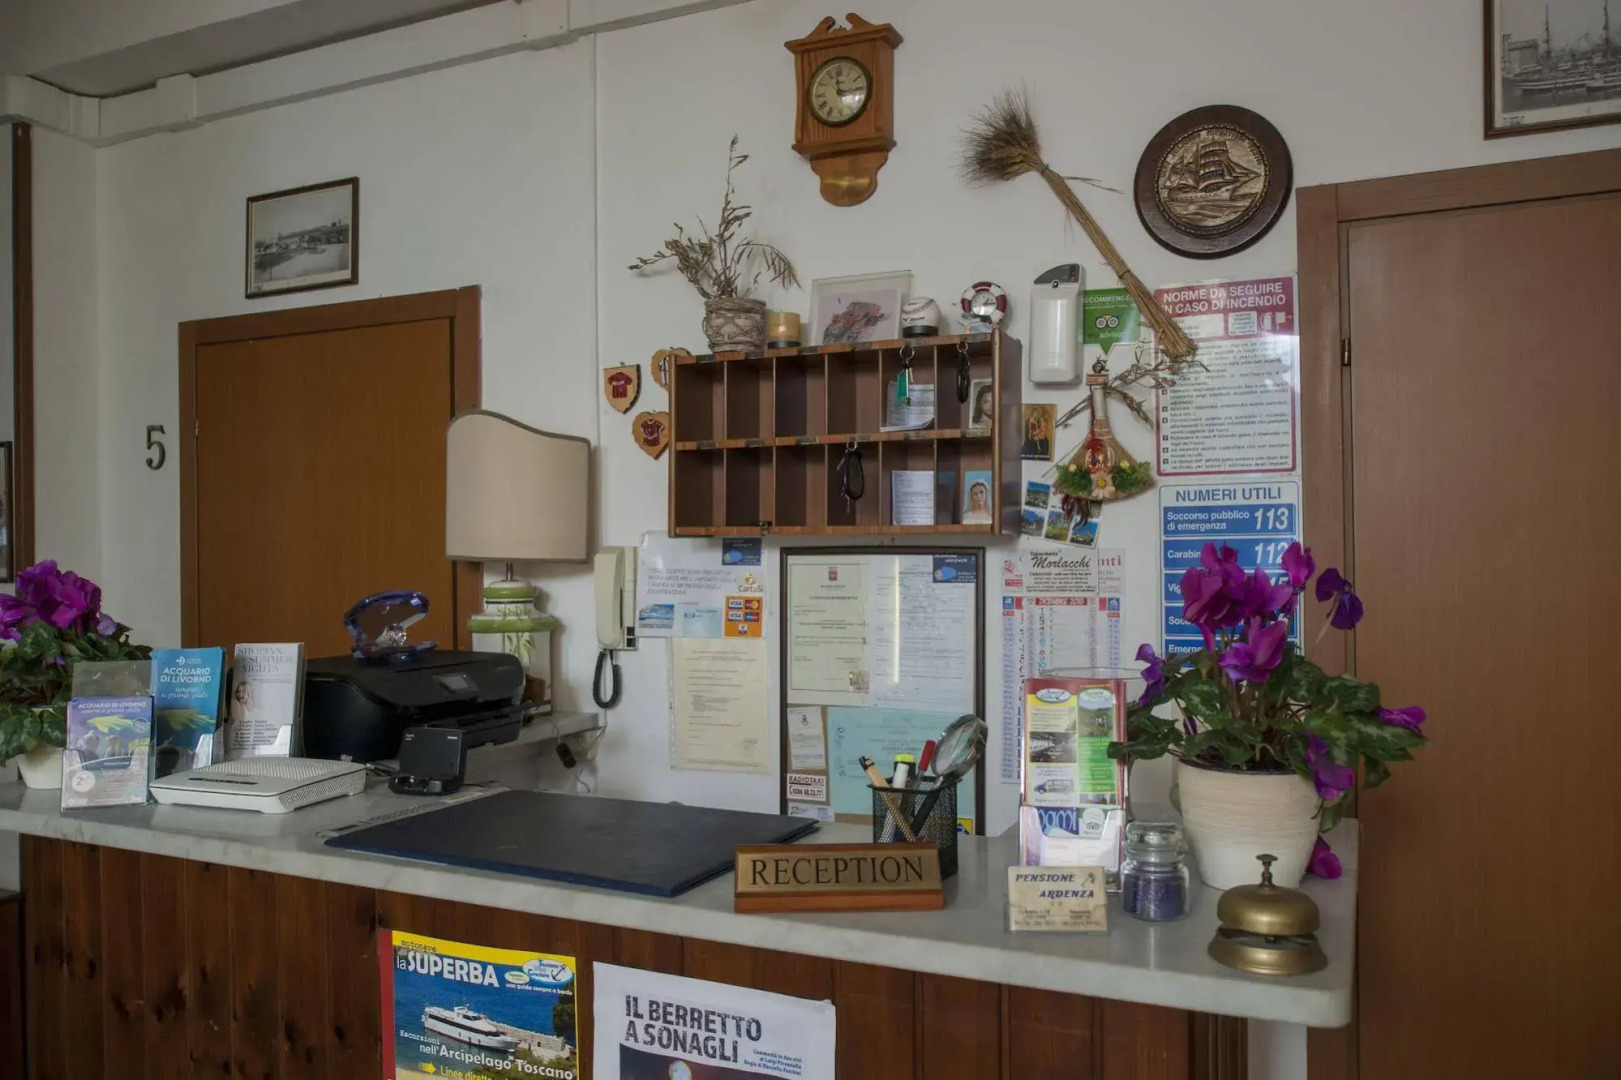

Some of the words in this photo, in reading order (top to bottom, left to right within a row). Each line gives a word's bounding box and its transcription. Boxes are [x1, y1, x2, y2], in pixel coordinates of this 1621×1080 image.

[1163, 288, 1206, 302] NORME
[1210, 288, 1226, 298] DA
[1229, 282, 1282, 297] SEGUIRE
[1175, 301, 1209, 313] CASO
[1211, 300, 1223, 310] DI
[1226, 294, 1286, 309] INCENDIO
[145, 424, 166, 470] 5
[1175, 488, 1236, 502] NUMERI
[1242, 486, 1281, 500] UTILI
[1166, 511, 1208, 521] Soccorso
[1211, 509, 1250, 523] pubblico
[1254, 507, 1289, 530] 113
[1167, 522, 1175, 531] di
[1177, 522, 1227, 533] emergenza
[1167, 549, 1200, 558] Carabin
[160, 675, 170, 683] DI
[172, 675, 212, 683] LIVORNO
[163, 667, 211, 676] ACQUARIO
[751, 856, 924, 886] RECEPTION
[1015, 873, 1076, 882] PENSIONE
[1039, 889, 1095, 899] ARDENZA
[401, 940, 437, 953] motonave
[396, 955, 407, 970] la
[407, 949, 500, 988] SUPERBA
[625, 994, 644, 1020] IL
[648, 999, 762, 1042] BERRETTO
[399, 1029, 441, 1046] Escursioni
[624, 1020, 640, 1044] A
[643, 1023, 739, 1064] SONAGLI
[440, 1065, 463, 1080] Linee
[515, 1058, 574, 1080] Toscano
